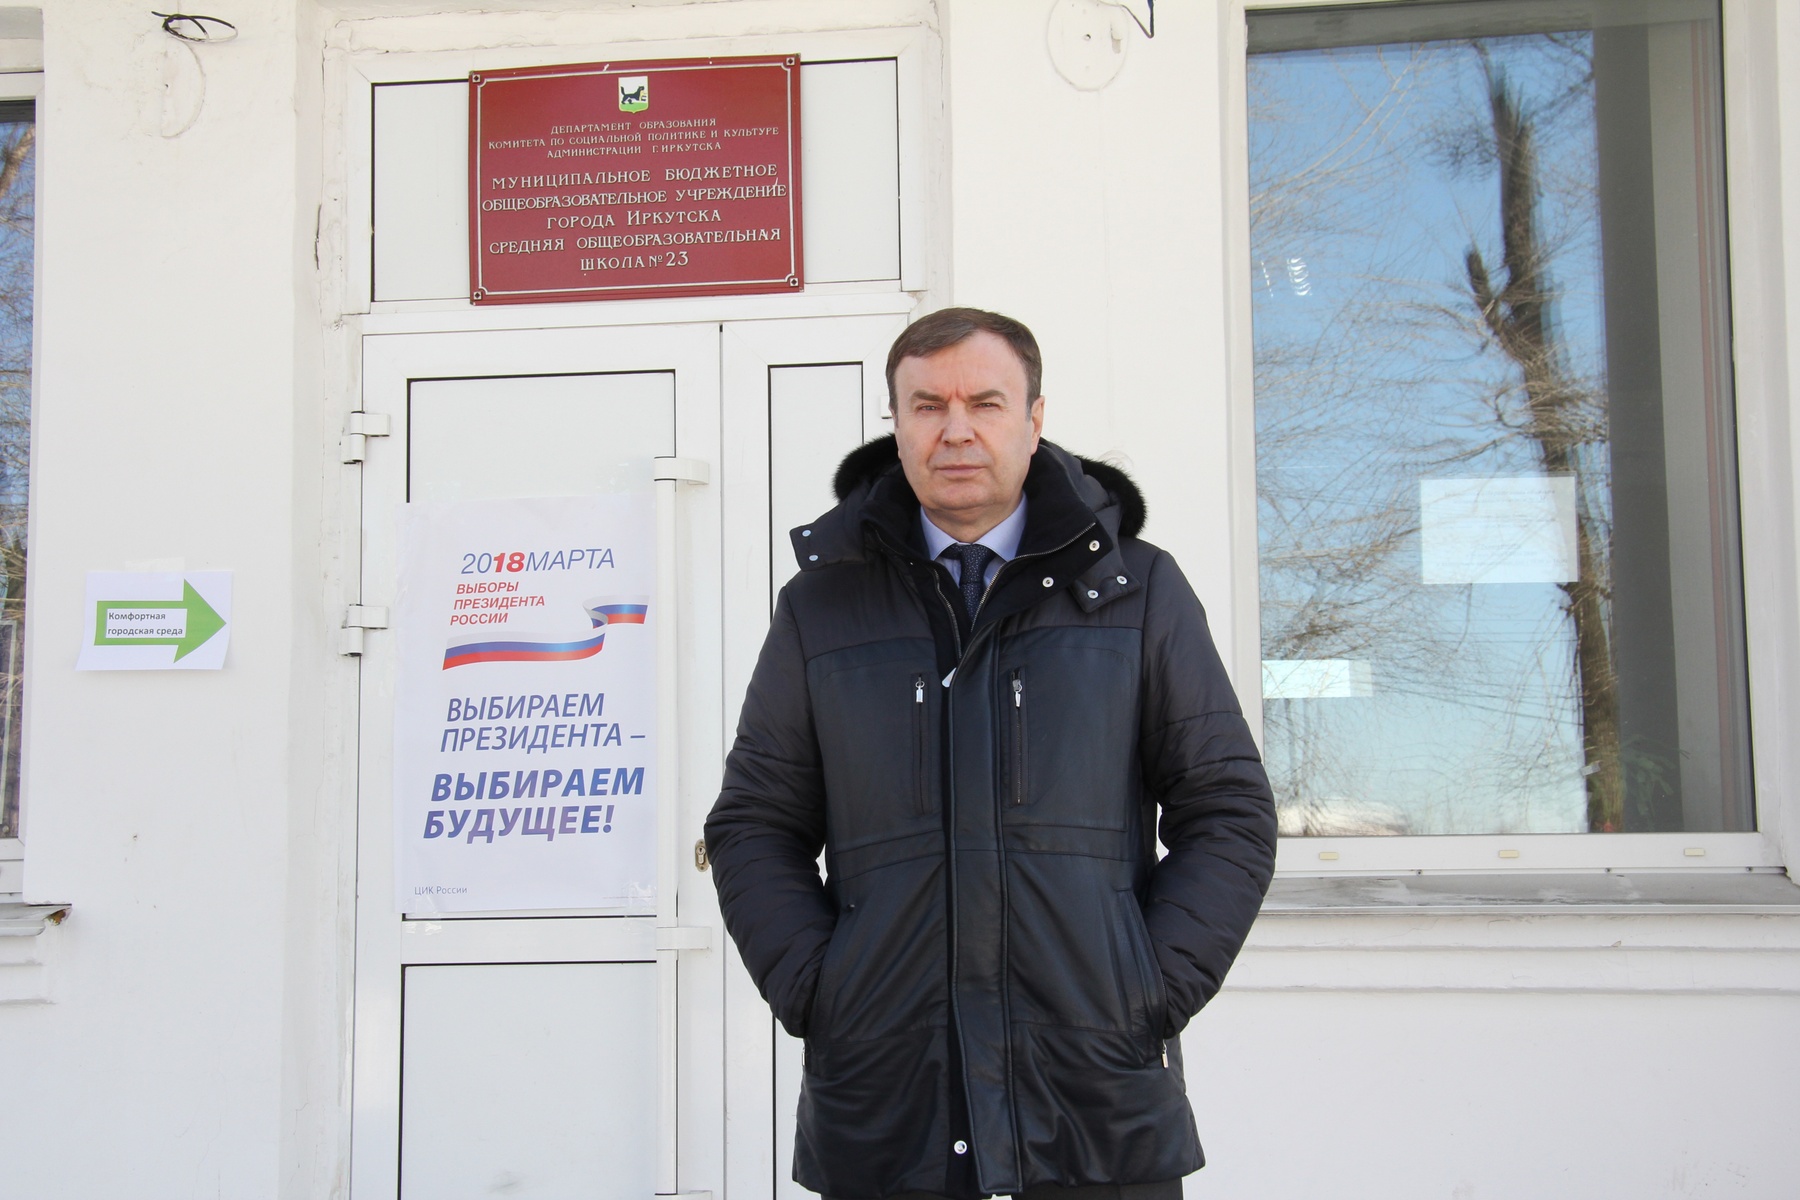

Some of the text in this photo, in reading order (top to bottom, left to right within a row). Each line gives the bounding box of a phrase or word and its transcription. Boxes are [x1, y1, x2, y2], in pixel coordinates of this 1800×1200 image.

[551, 118, 717, 135] ДЕПАРТАМЕНТ ОБРАЗОВАНИЯ
[488, 127, 779, 150] КОМИТЕТА ПО СОЦИАЛЬНОЙ ПОЛИТИКЕ И КУЛЬТУРЕ
[547, 145, 641, 159] АДМИНИСТРАЦИИ
[492, 164, 778, 190] МУНИЦИПАЛЬНОЕ БЮДЖЕТНОЕ
[482, 184, 787, 212] ОБЩЕОБРАЗОВАТЕЛЬНОЕ УЧРЕЖДЕНИЕ
[547, 209, 722, 230] ГОРОДА ИРКУТСКА
[489, 228, 781, 255] СРЕДНЯЯ ОБЩЕОБРАЗОВАТЕЛЬНАЯ
[580, 256, 645, 271] ШКОЛА
[456, 581, 519, 594] ВЫБОРЫ
[453, 595, 545, 611] ПРЕЗИДЕНТА
[108, 612, 166, 621] Комфортная
[450, 613, 508, 626] РОССИИ
[447, 693, 604, 722] ВЫБИРАЕМ
[440, 723, 622, 754] ПРЕЗИДЕНТА
[431, 767, 645, 802] ВЫБИРАЕМ
[423, 804, 615, 844] БУДУЩЕЕ!
[414, 885, 468, 895] ЦИК России
